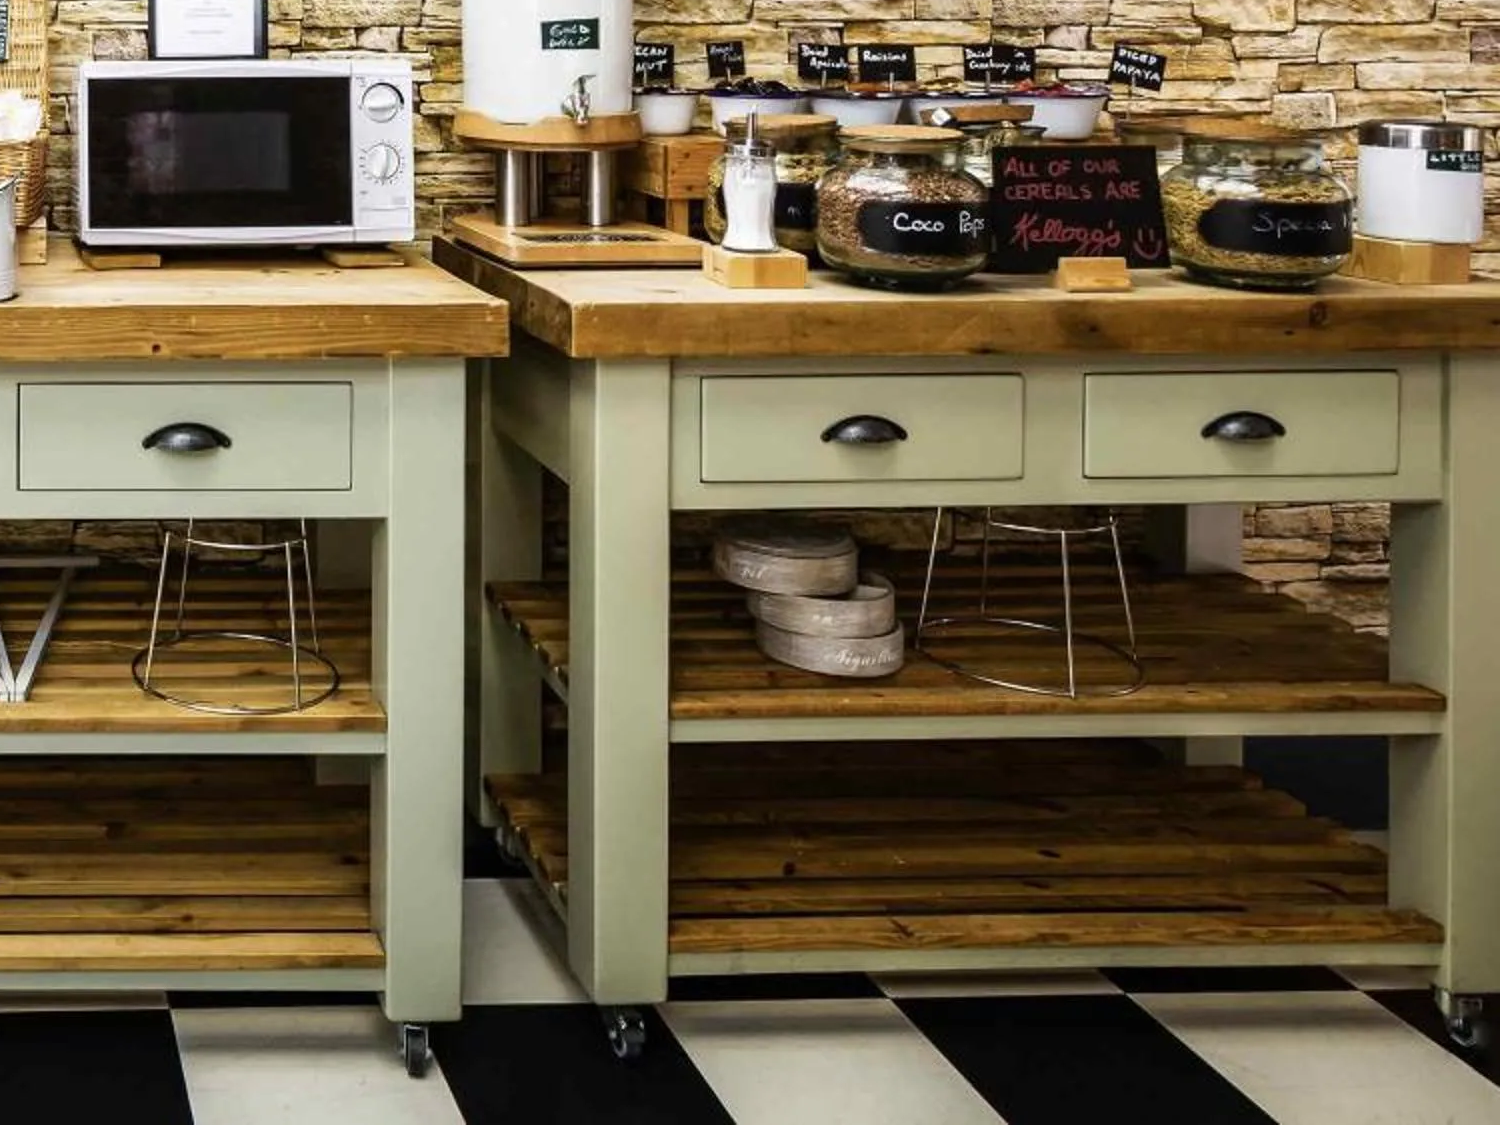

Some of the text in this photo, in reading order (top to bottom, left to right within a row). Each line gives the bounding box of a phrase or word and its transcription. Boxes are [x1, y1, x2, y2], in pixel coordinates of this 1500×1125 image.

[1003, 156, 1120, 177] ALL OF OUR
[1004, 180, 1141, 200] CEREALS ARE
[892, 210, 985, 239] Coco Pops
[1010, 211, 1122, 256] Kellogg's
